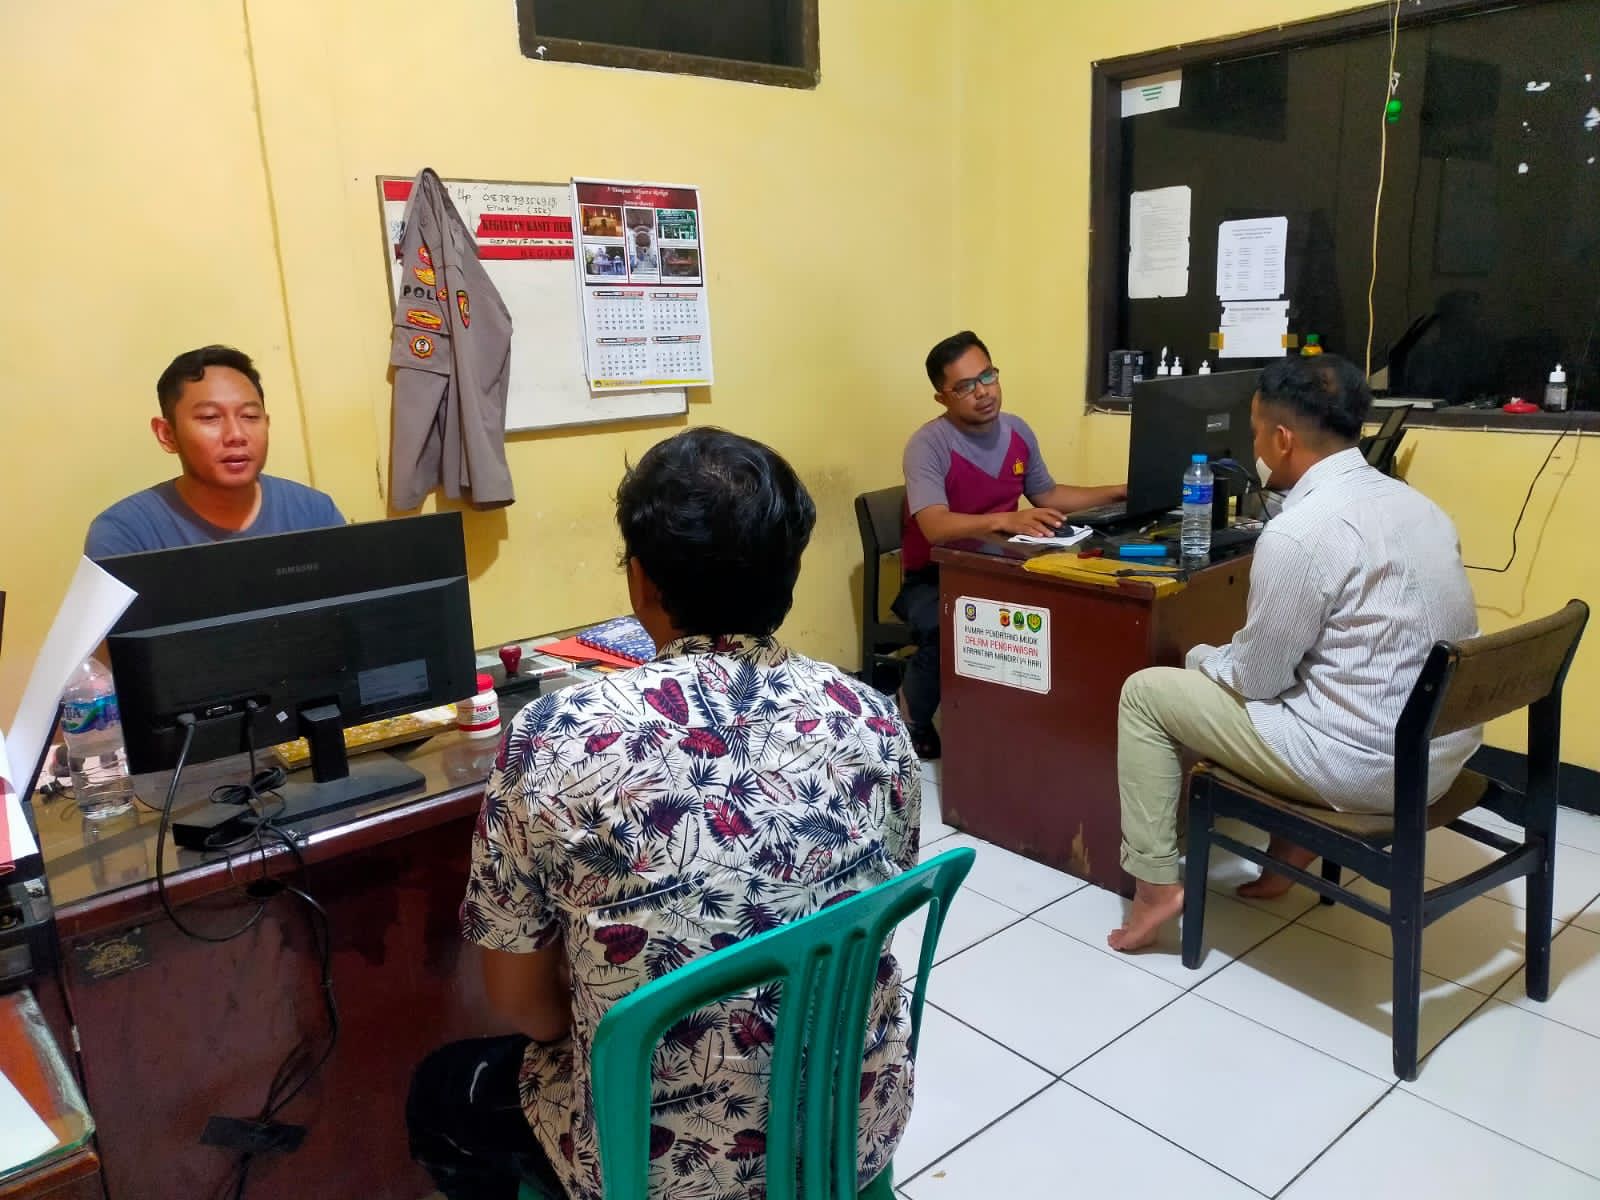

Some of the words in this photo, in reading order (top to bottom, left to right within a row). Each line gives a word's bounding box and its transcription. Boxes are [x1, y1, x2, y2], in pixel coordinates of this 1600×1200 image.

[403, 284, 438, 302] POL
[964, 624, 984, 635] RUMAH
[965, 635, 989, 648] DALAM
